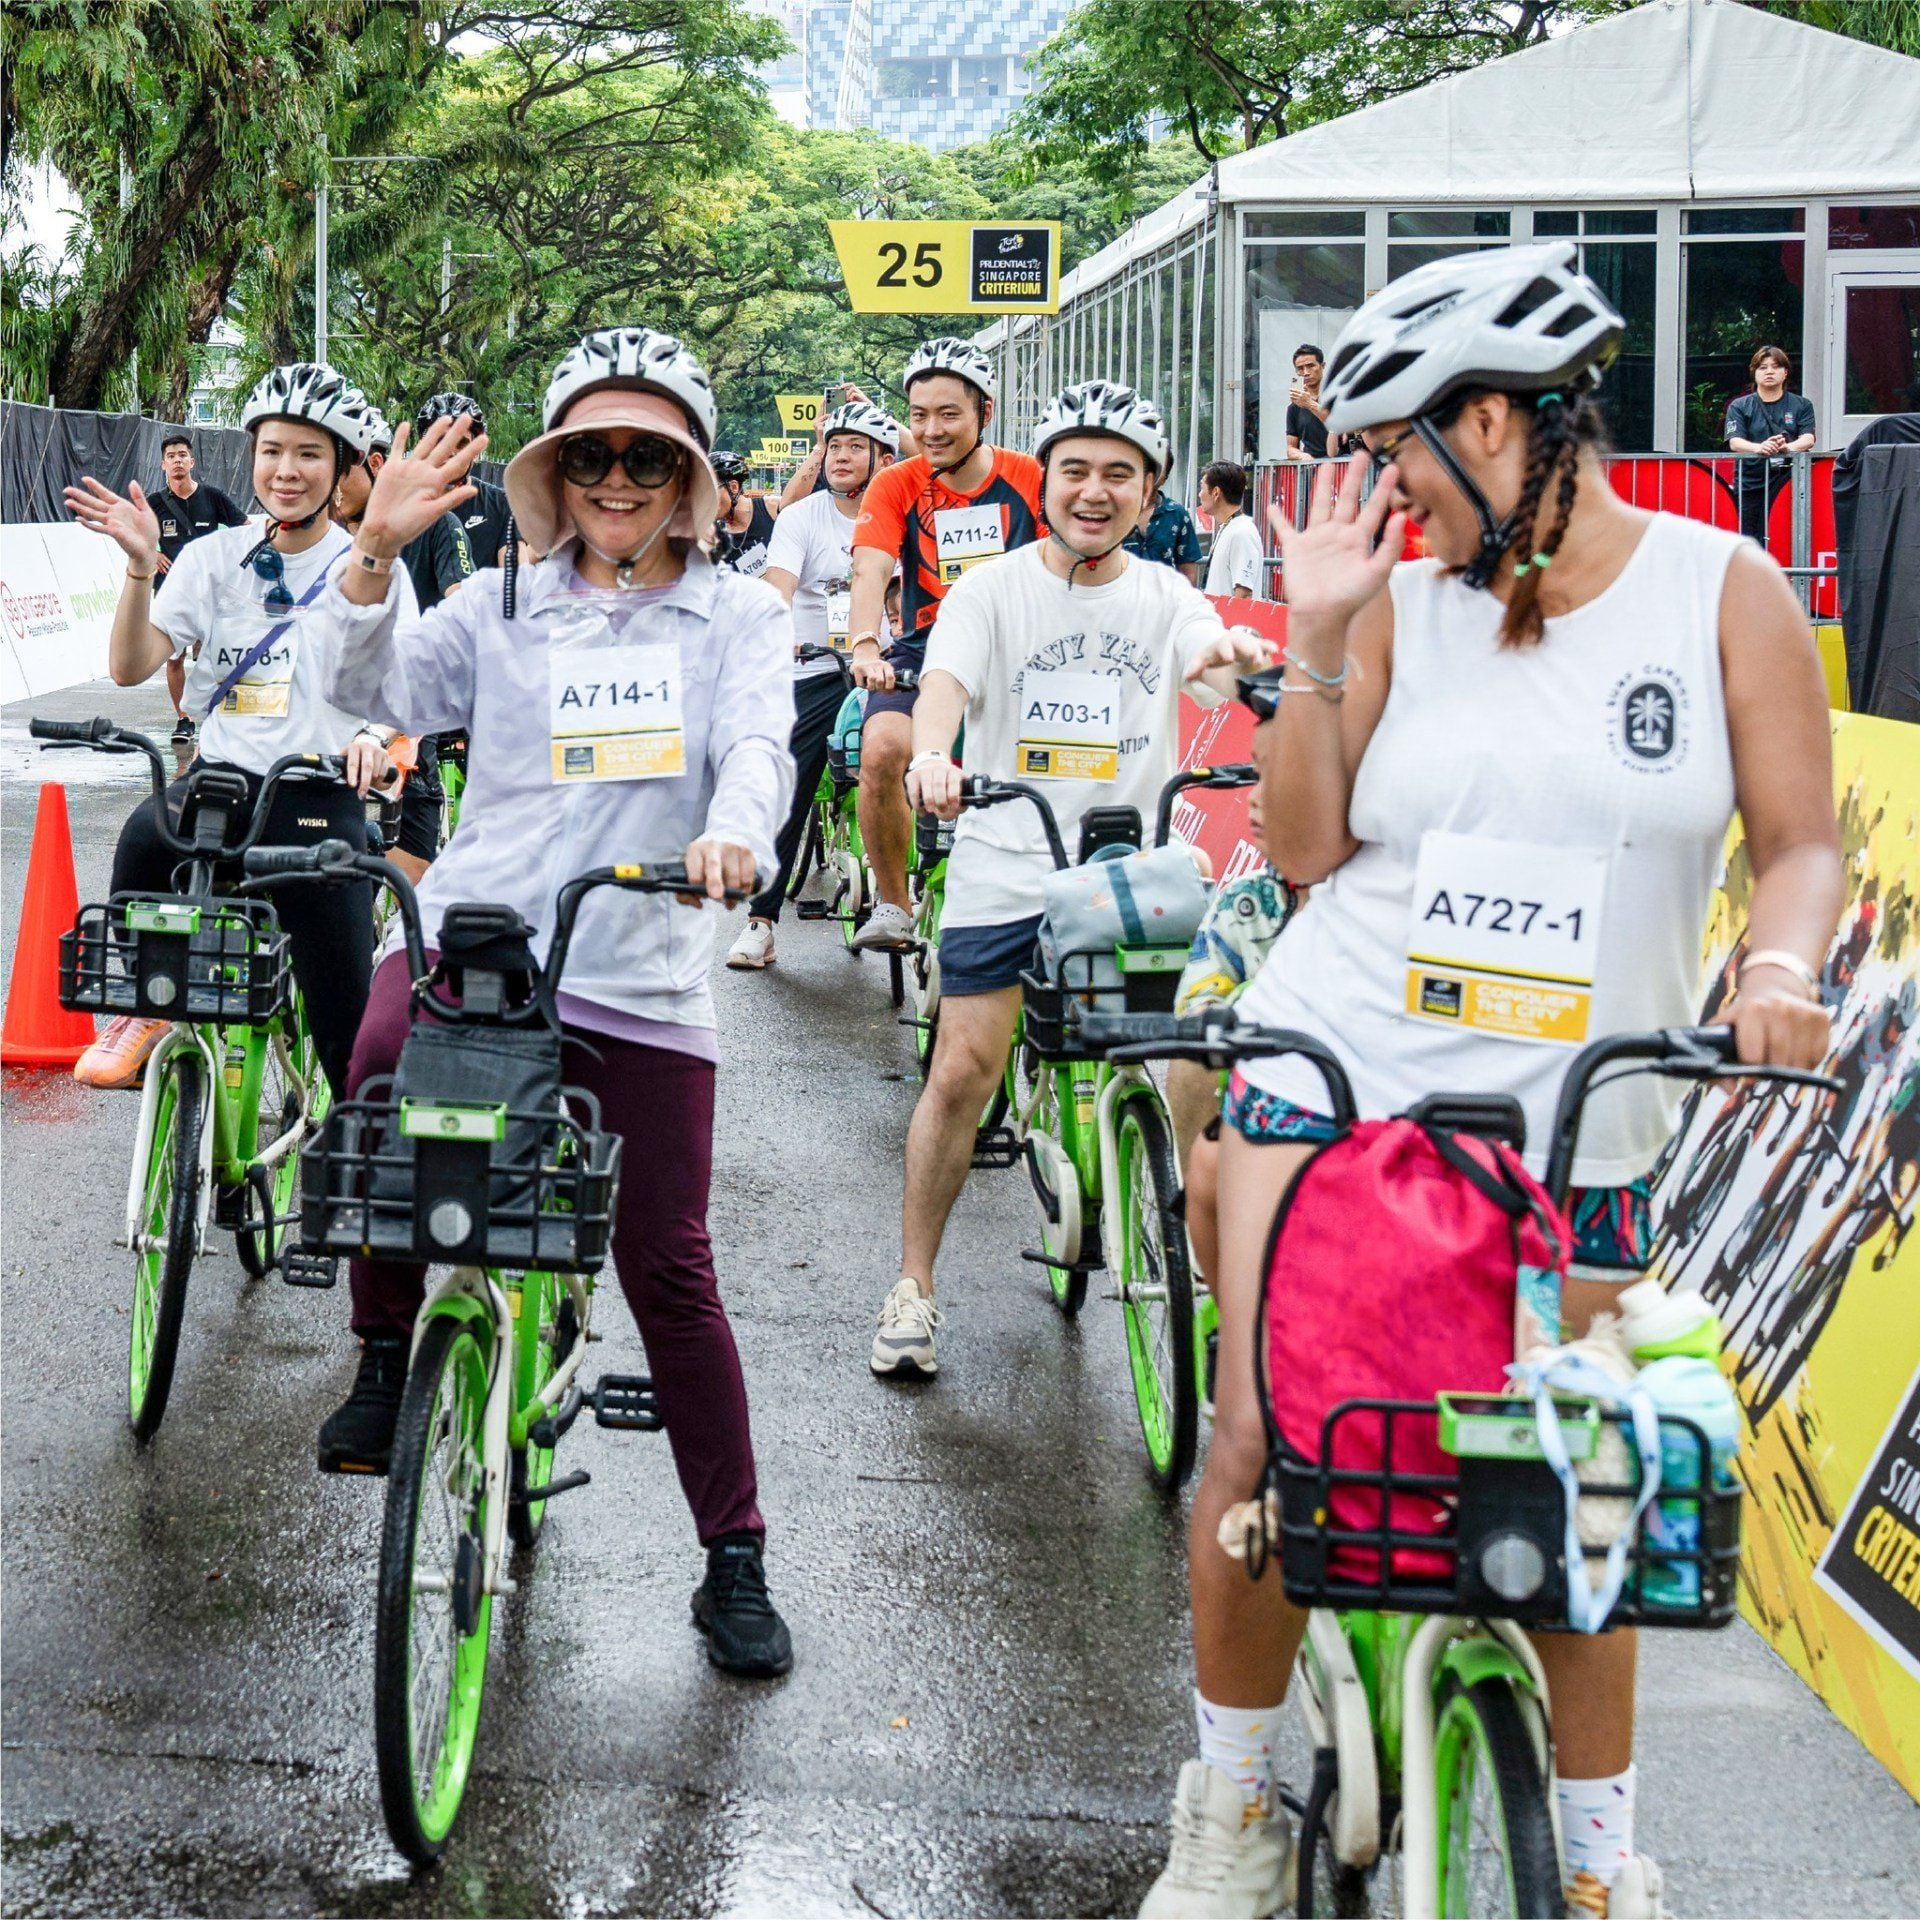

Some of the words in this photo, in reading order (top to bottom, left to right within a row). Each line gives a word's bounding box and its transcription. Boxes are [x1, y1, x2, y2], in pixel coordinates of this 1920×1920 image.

[876, 242, 943, 288] 25
[979, 259, 1028, 269] PRUDENTIAL
[979, 271, 1041, 281] SINGAPORE
[979, 282, 1041, 295] CRITERIUM
[793, 404, 817, 420] 50
[768, 442, 789, 453] 100
[942, 525, 998, 545] A711-2
[217, 647, 290, 666] A78-1
[559, 680, 669, 709] A714-1
[1027, 701, 1110, 725] A703-1
[1118, 733, 1150, 755] ATION
[1423, 890, 1582, 941] A727-1
[1880, 1457, 1920, 1527] SIN
